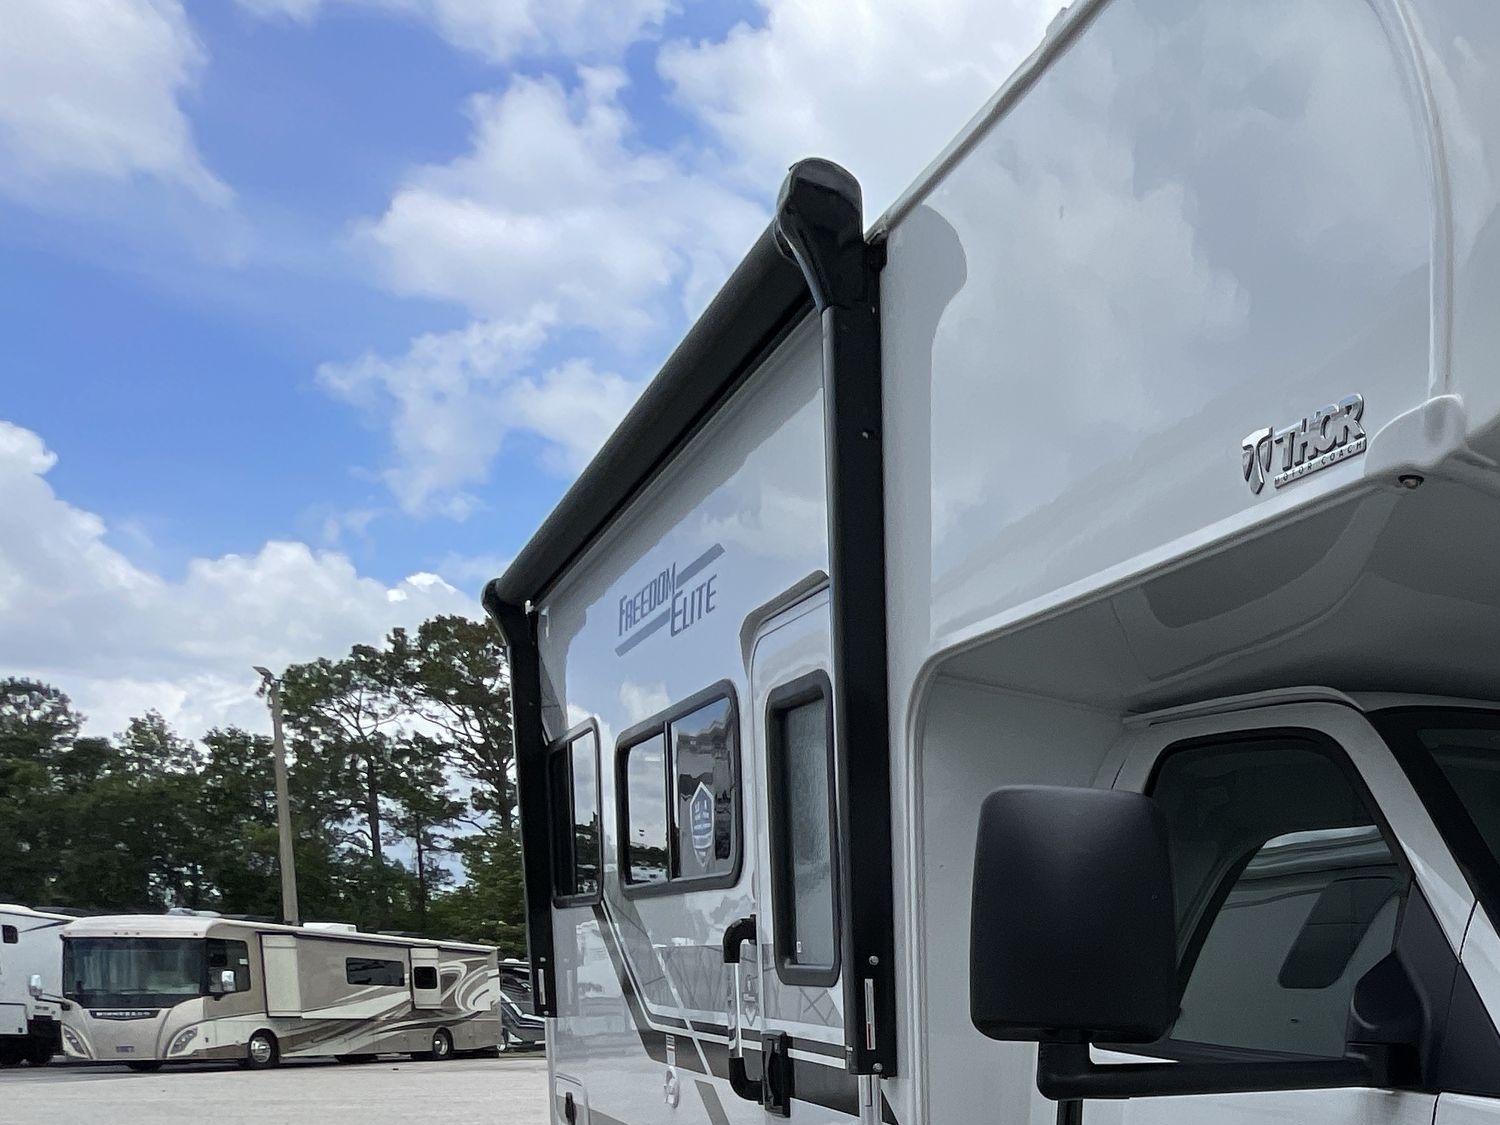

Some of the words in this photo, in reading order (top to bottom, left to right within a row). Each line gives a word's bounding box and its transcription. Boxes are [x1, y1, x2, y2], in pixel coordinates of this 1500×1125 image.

[1274, 393, 1366, 471] THOR
[1321, 443, 1362, 465] COACH
[618, 562, 676, 637] FREEDOM
[671, 574, 718, 637] ELITE
